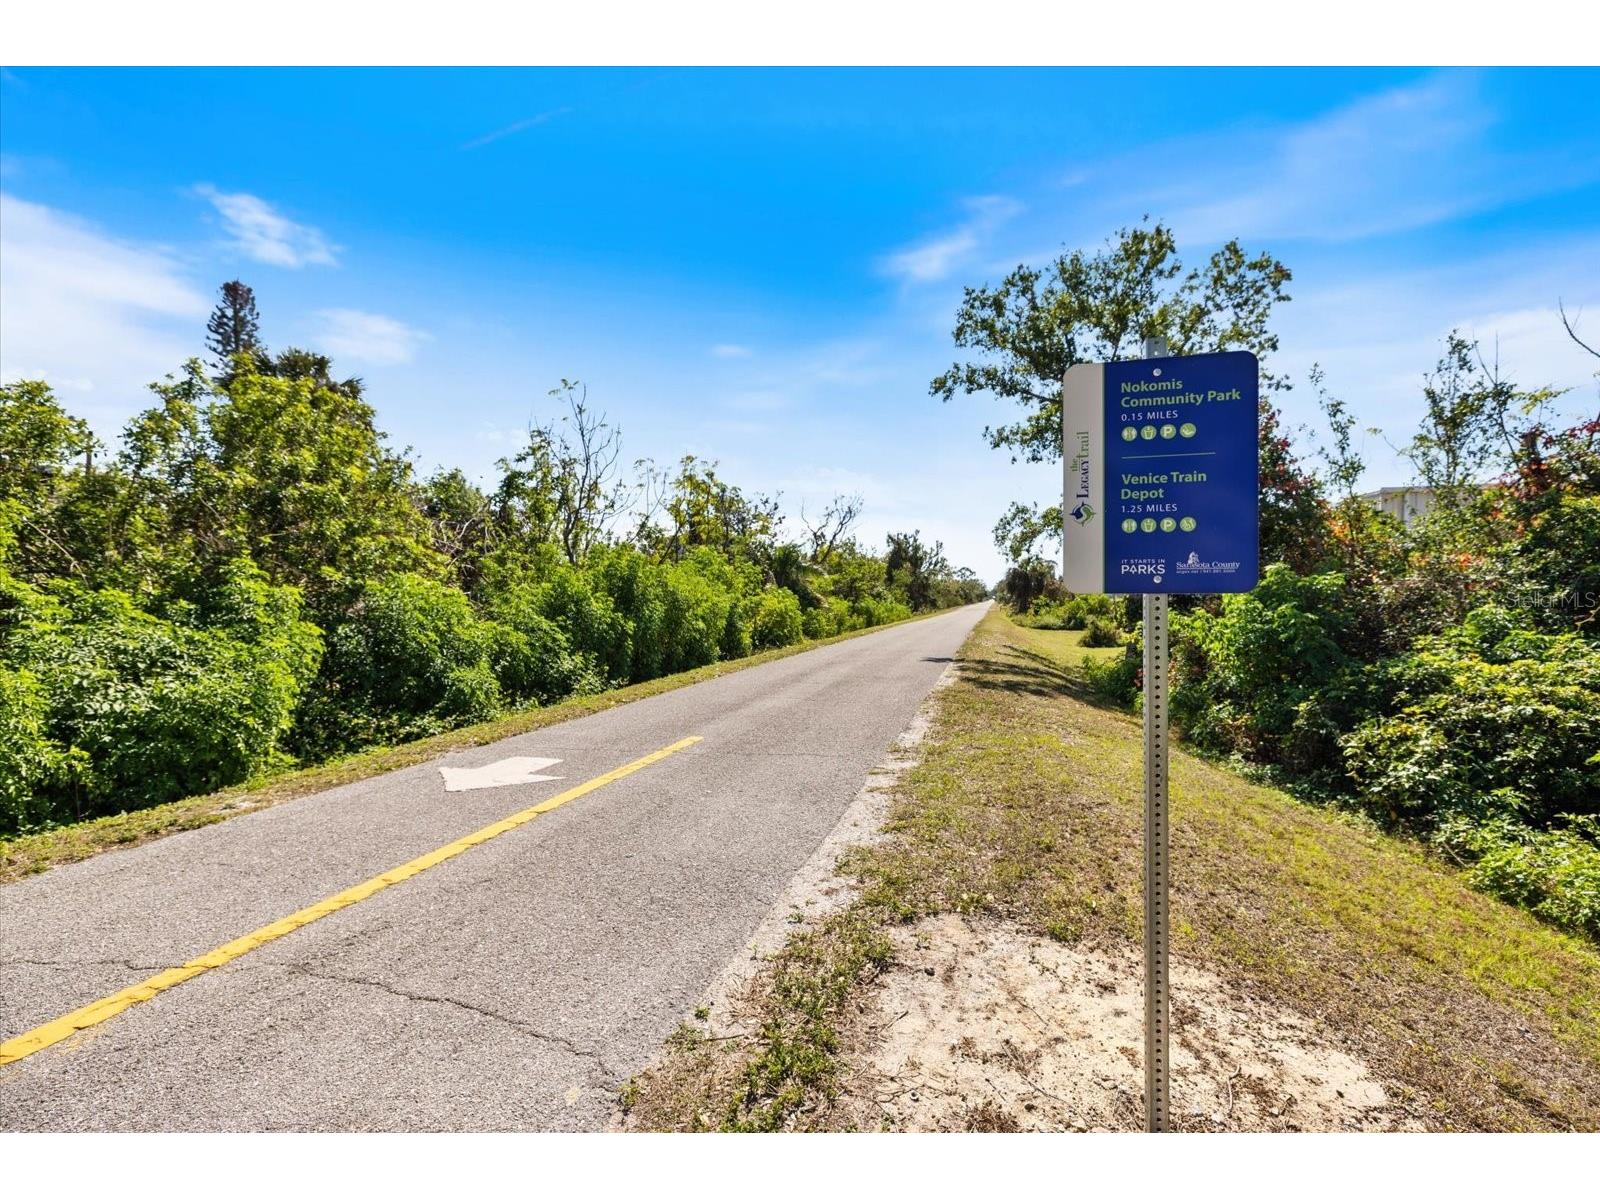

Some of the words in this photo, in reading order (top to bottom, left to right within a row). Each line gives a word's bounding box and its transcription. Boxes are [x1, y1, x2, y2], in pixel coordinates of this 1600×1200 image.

[1120, 378, 1183, 393] Nokomis
[1120, 391, 1203, 408] Community
[1207, 388, 1241, 402] Park
[1121, 412, 1143, 422] 0.15
[1147, 410, 1178, 420] MILES
[1075, 431, 1089, 459] trail
[1069, 458, 1078, 472] the
[1121, 473, 1168, 485] Venice
[1170, 470, 1207, 483] Train
[1120, 488, 1164, 501] Depot
[1121, 504, 1143, 513] 1.25
[1146, 503, 1178, 513] MILES
[1121, 564, 1166, 575] PARKS
[1211, 561, 1241, 569] County
